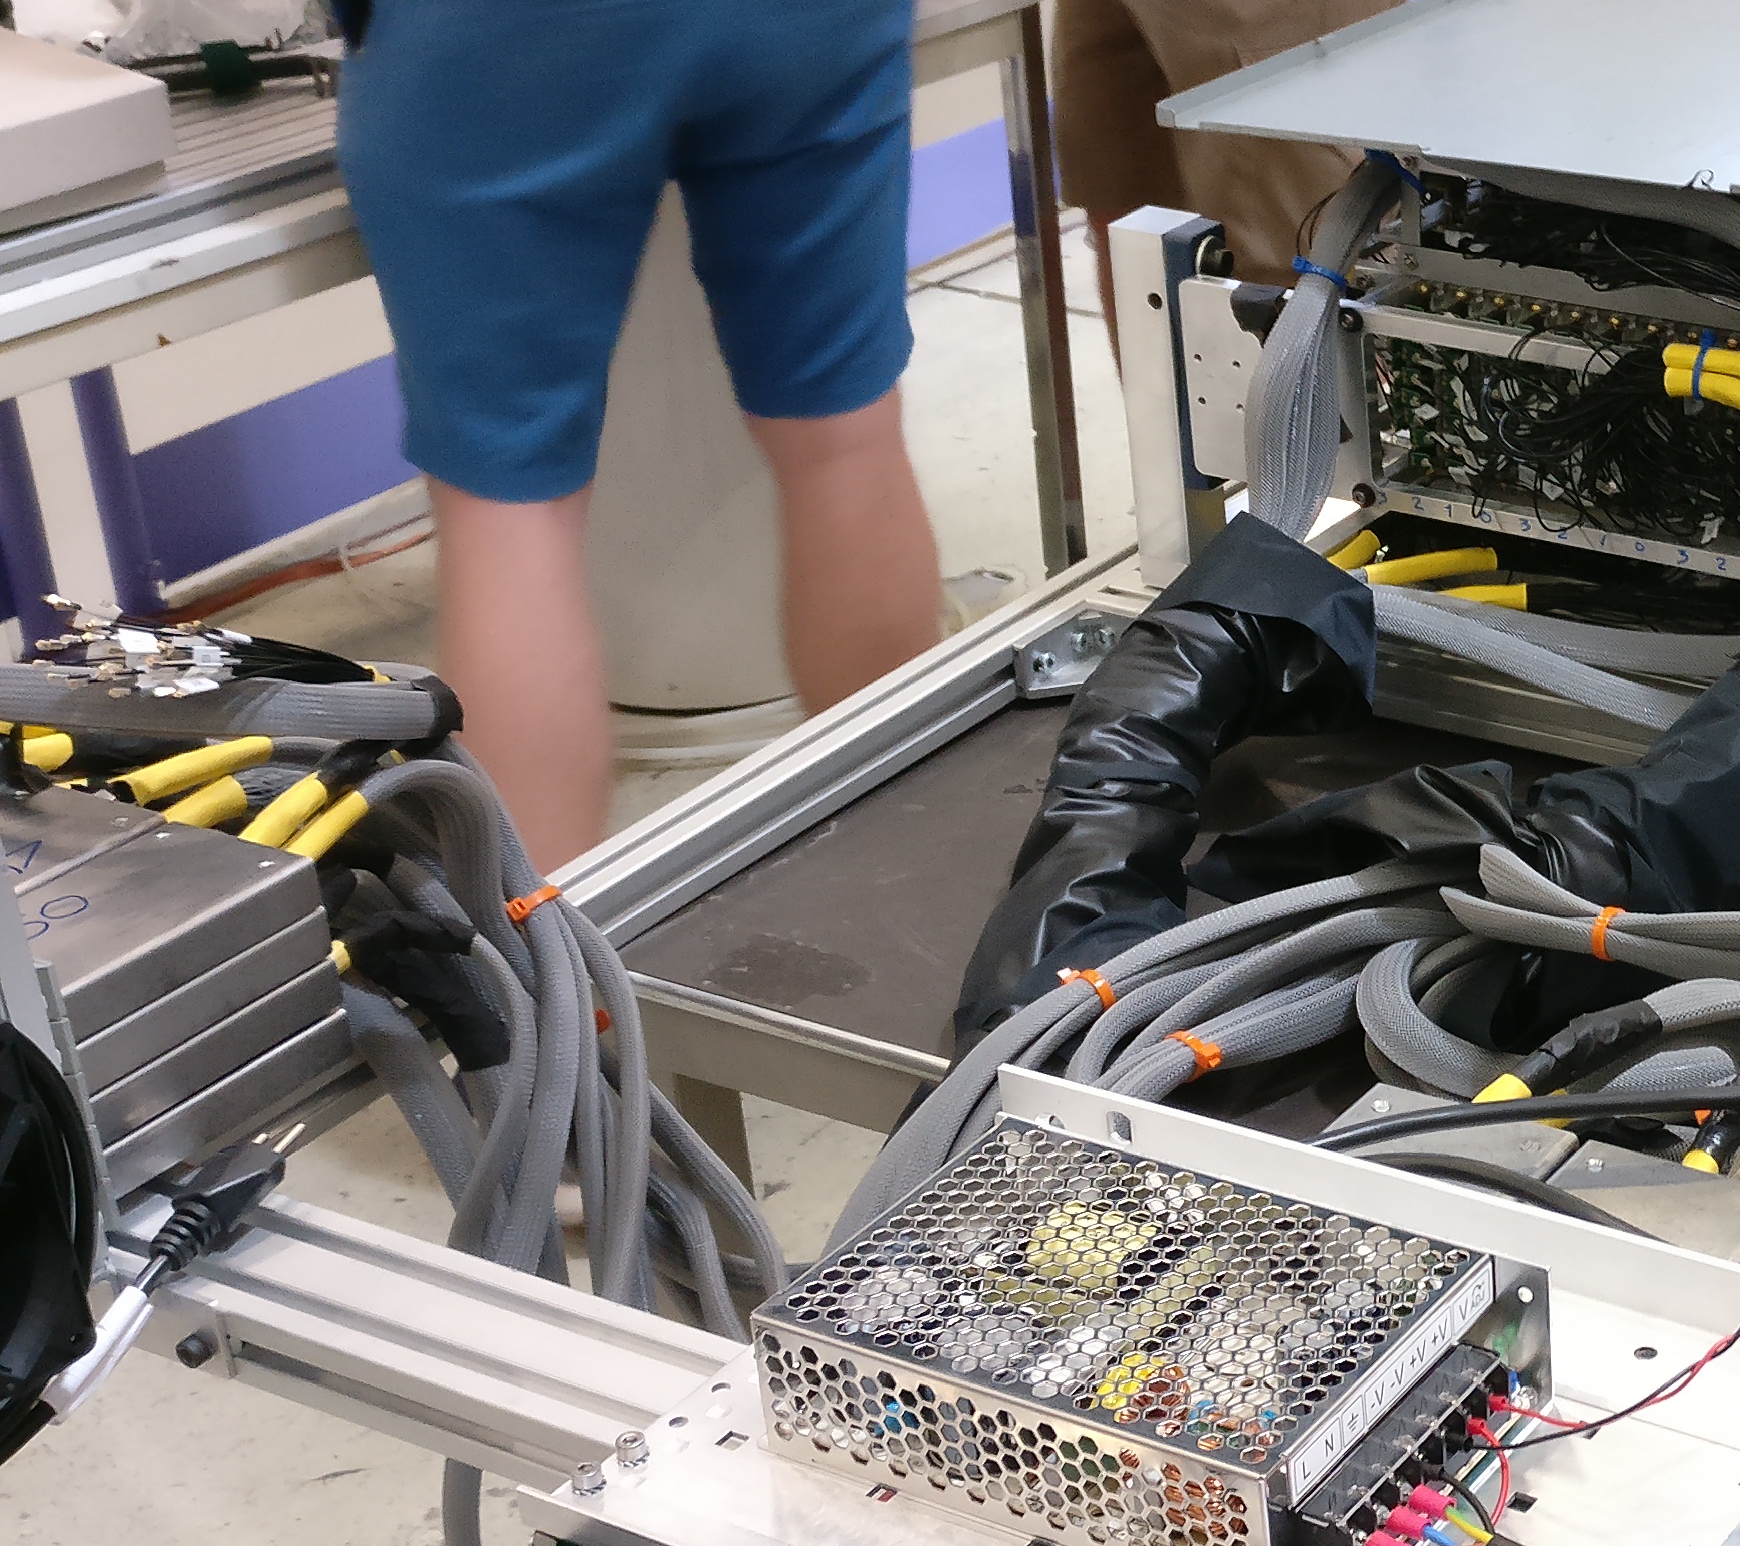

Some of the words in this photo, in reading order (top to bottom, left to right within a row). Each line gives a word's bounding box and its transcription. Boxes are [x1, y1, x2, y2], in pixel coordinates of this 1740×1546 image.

[1411, 497, 1424, 511] 2
[1444, 504, 1453, 518] 1
[1479, 510, 1492, 524] 0
[1519, 518, 1532, 532] 3
[1634, 541, 1646, 552] 0
[1715, 557, 1727, 571] 2
[1302, 1461, 1312, 1480] L
[1324, 1436, 1335, 1458] N
